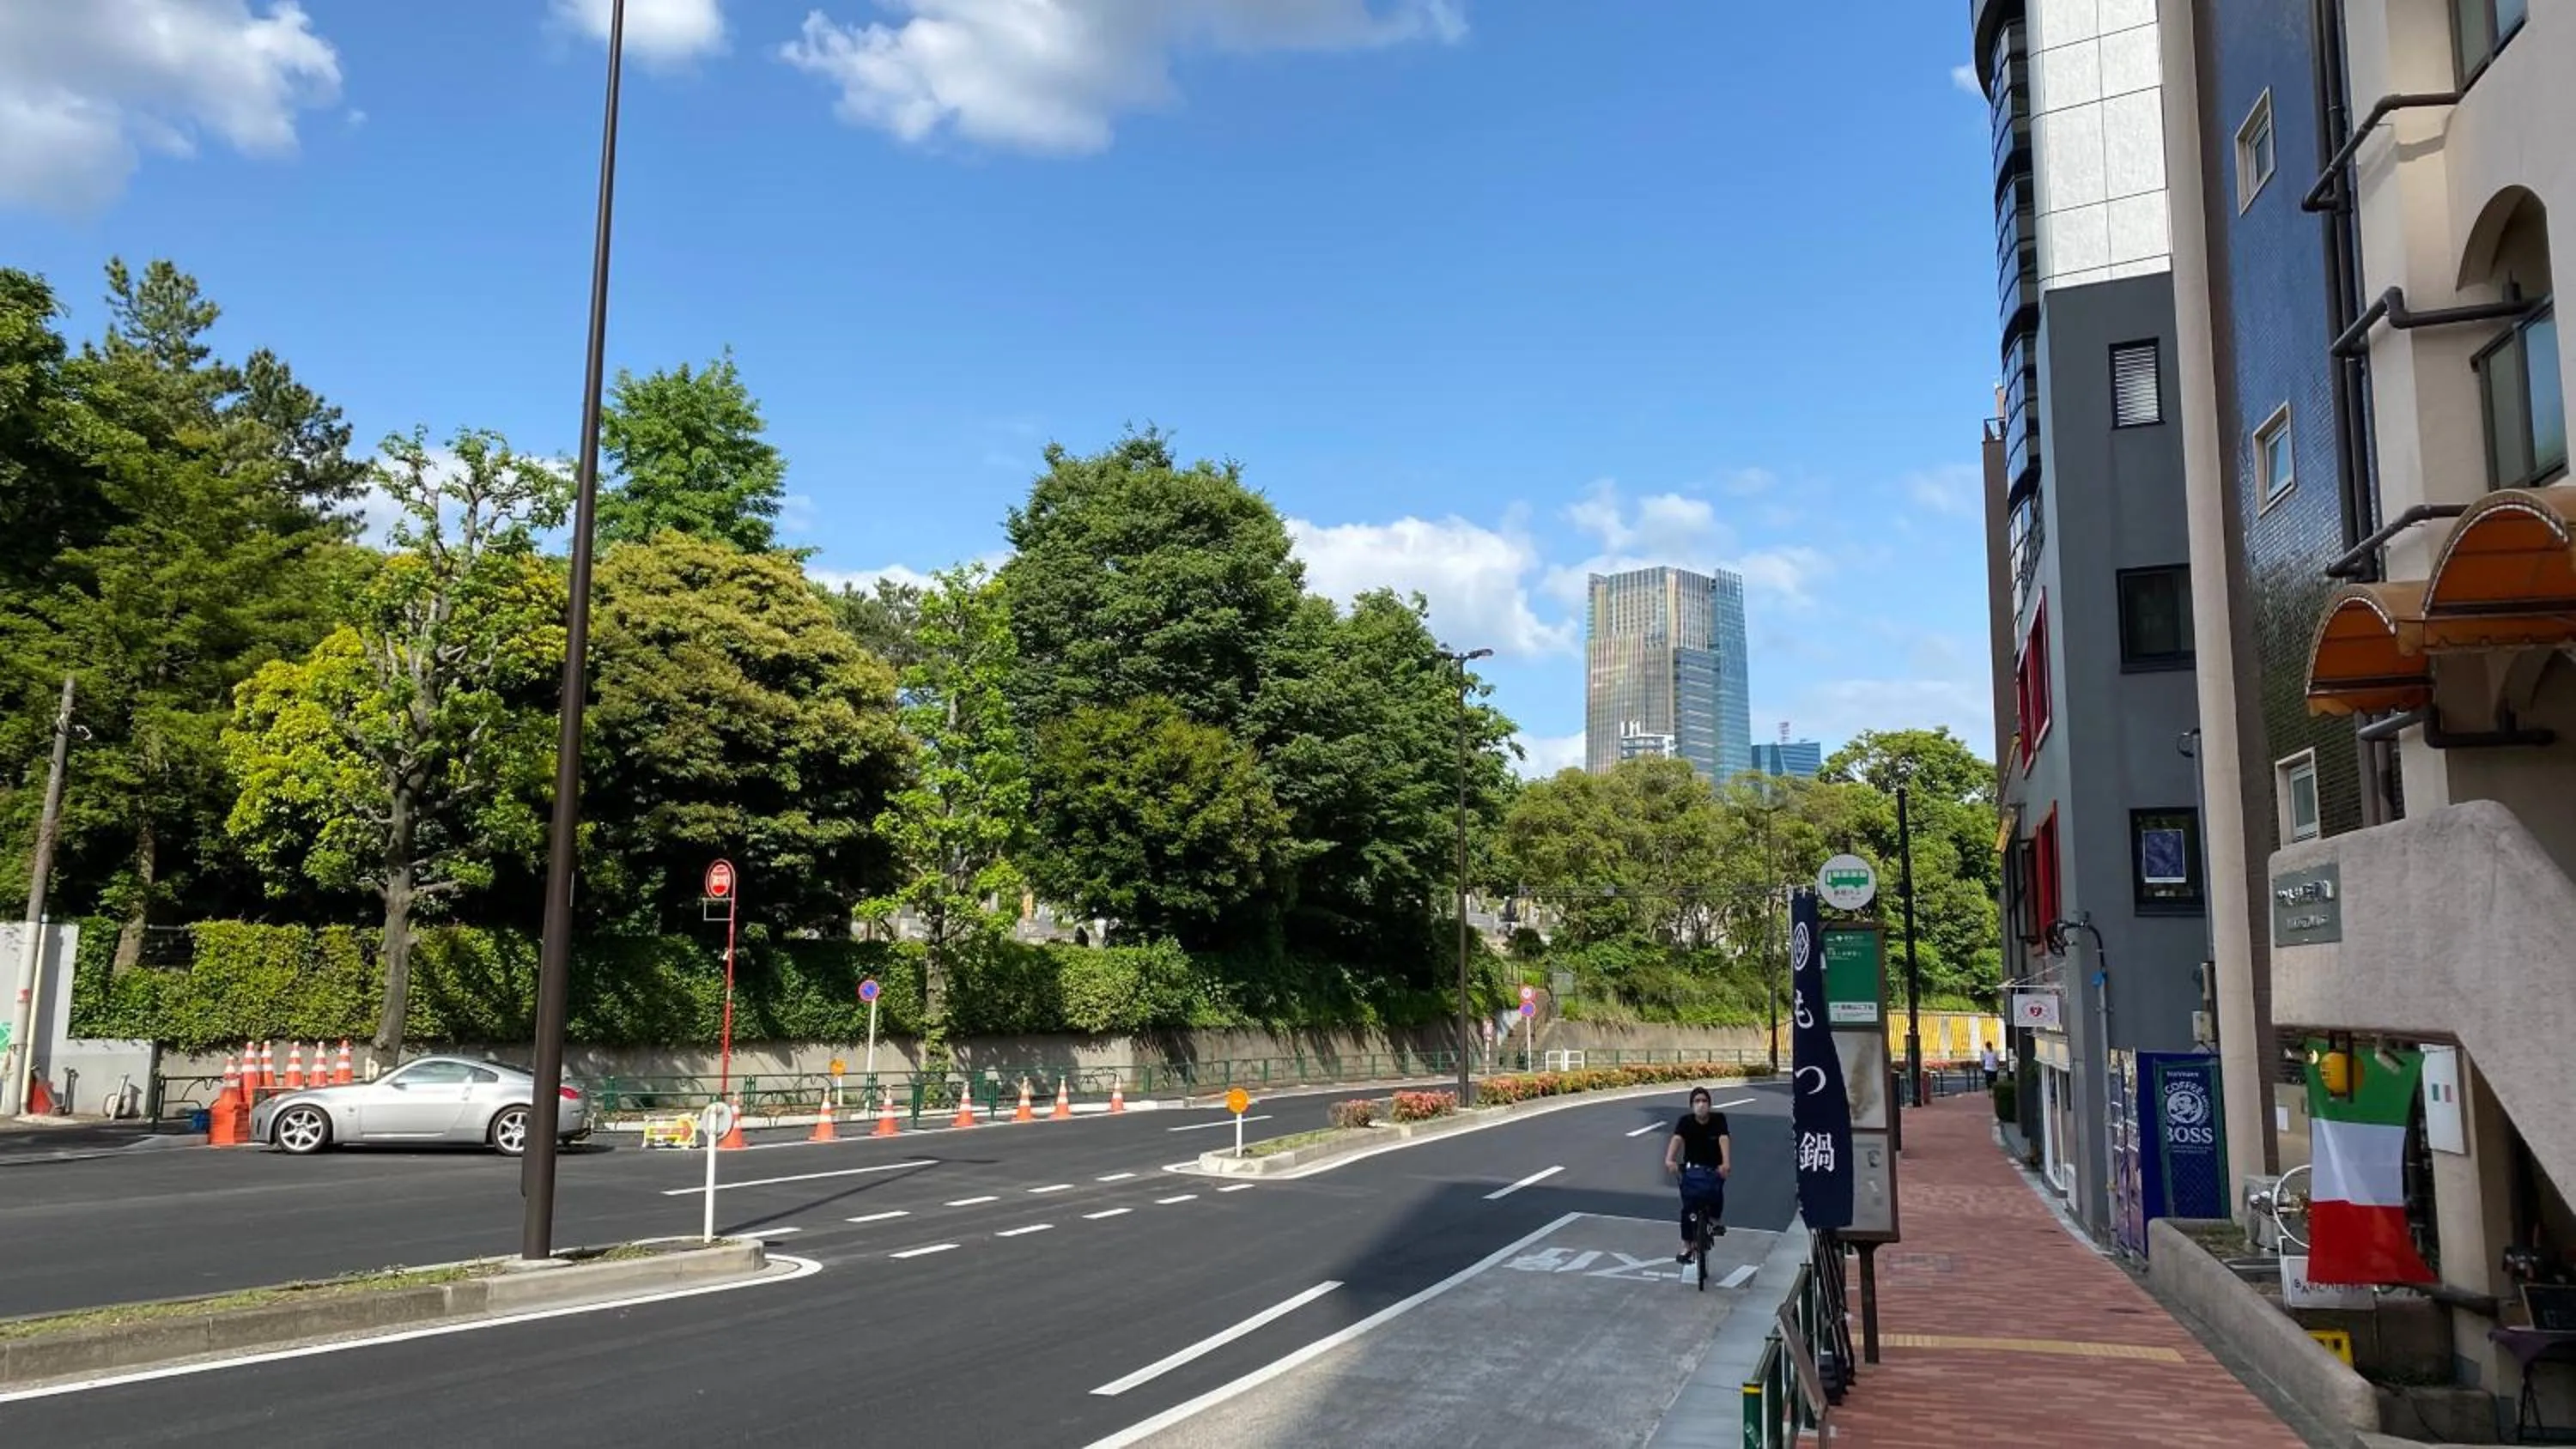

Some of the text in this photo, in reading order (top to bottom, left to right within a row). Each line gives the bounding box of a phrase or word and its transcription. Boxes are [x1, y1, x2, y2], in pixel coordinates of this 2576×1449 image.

[1794, 988, 1835, 1172] もつ鍋
[2165, 1081, 2204, 1095] COFFEE
[2166, 1125, 2213, 1144] BOSS
